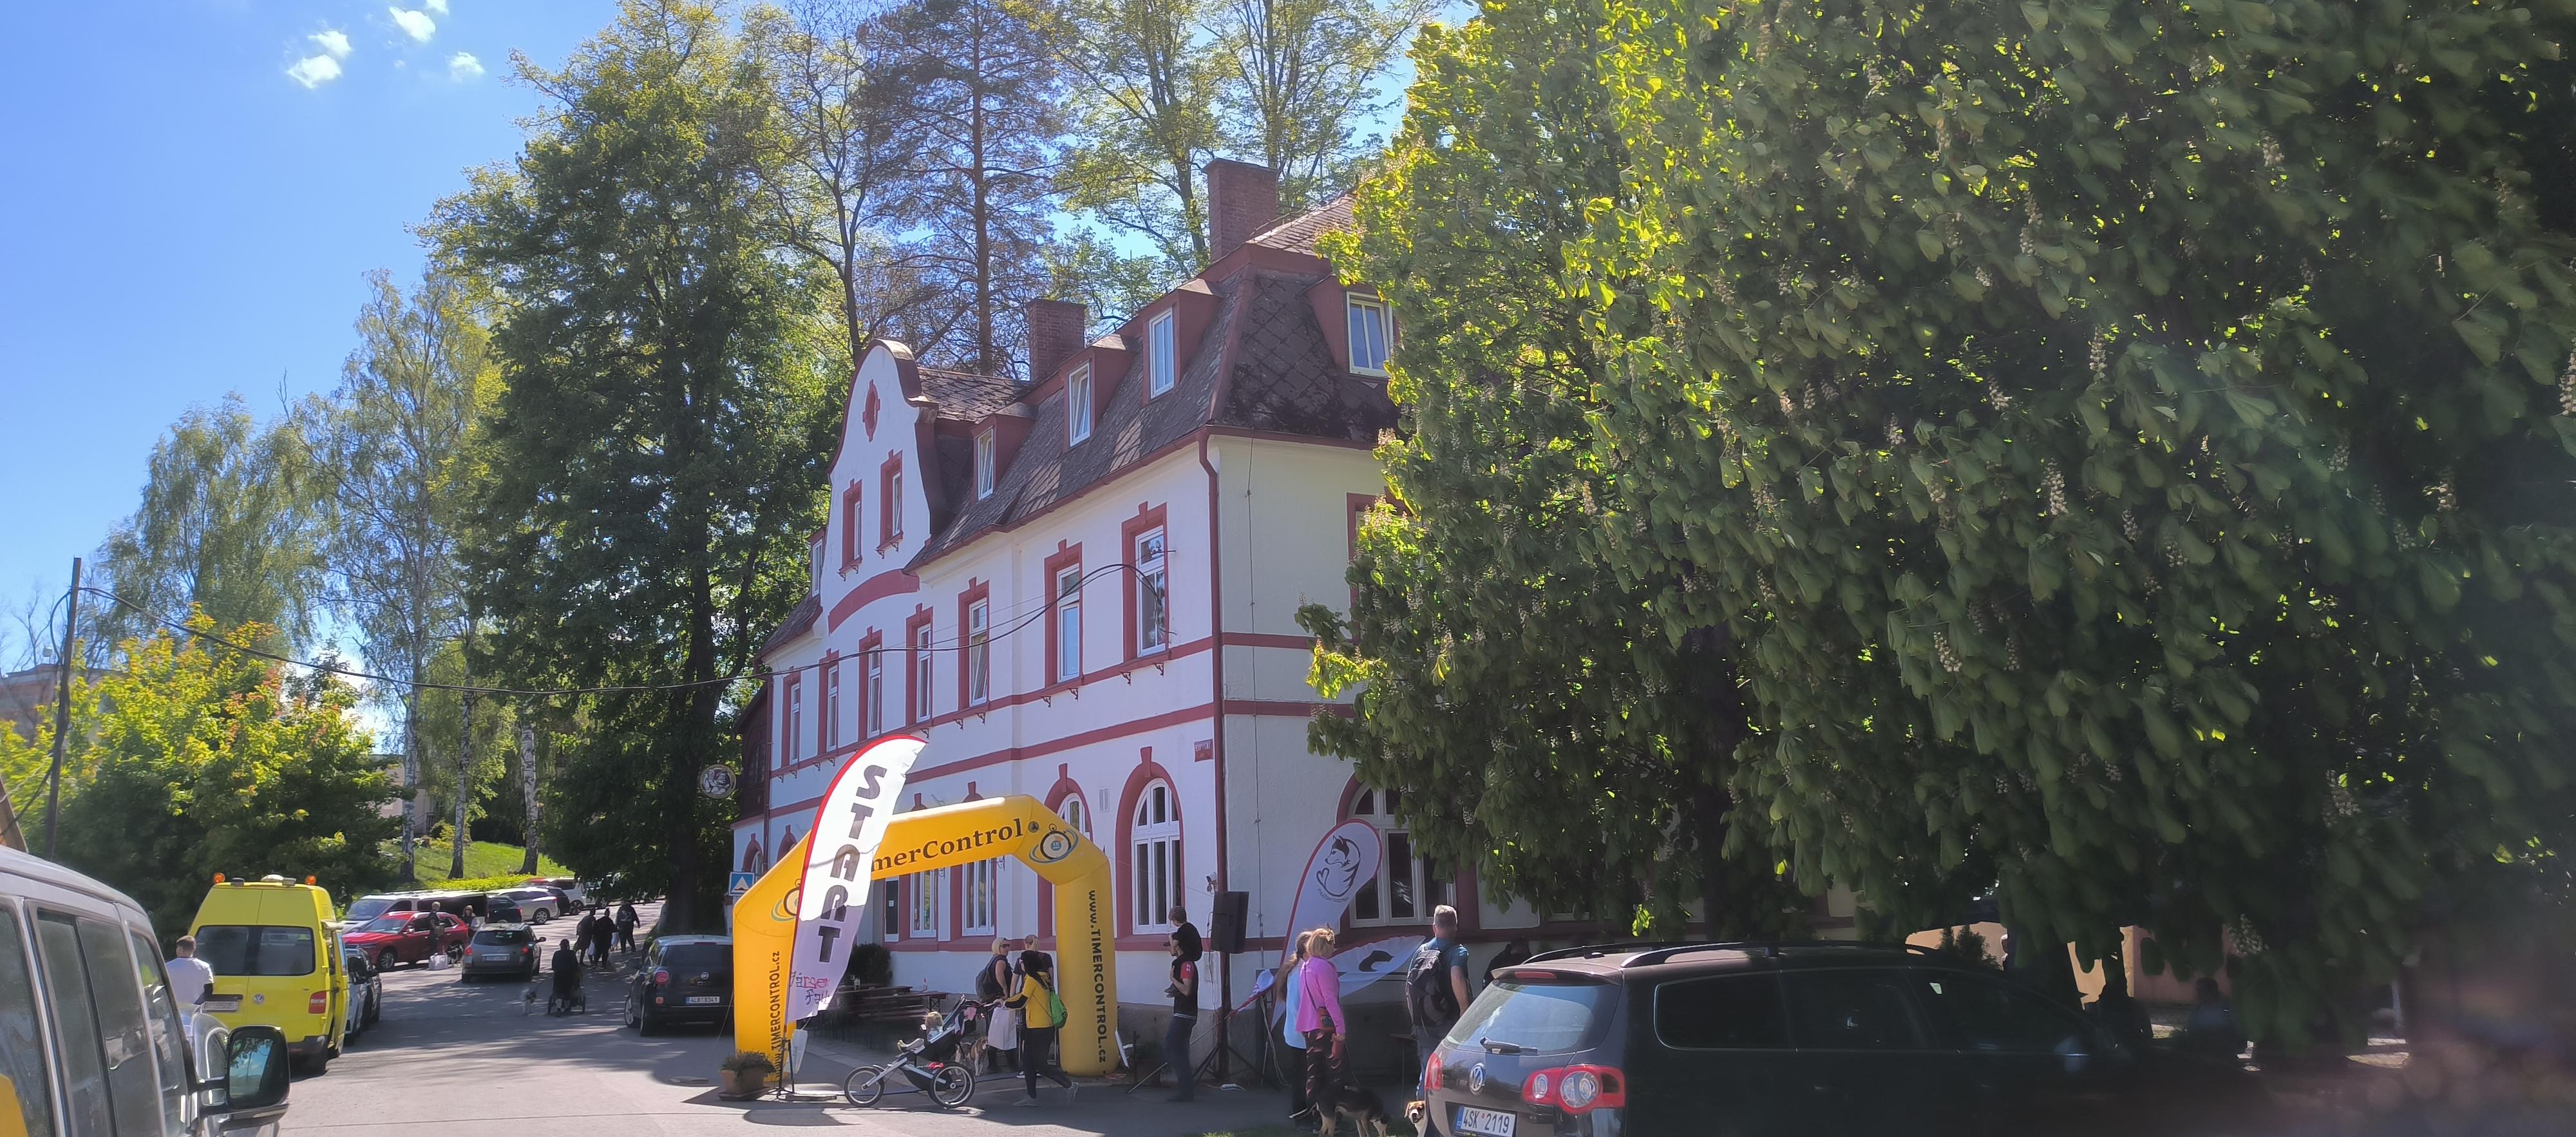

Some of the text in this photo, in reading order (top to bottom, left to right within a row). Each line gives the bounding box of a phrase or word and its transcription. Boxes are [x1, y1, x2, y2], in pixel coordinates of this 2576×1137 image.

[819, 765, 887, 963] START
[871, 818, 1023, 872] merControl
[1088, 890, 1107, 1063] www.TIMERCONTROL.cz
[1484, 1113, 1510, 1134] 2119
